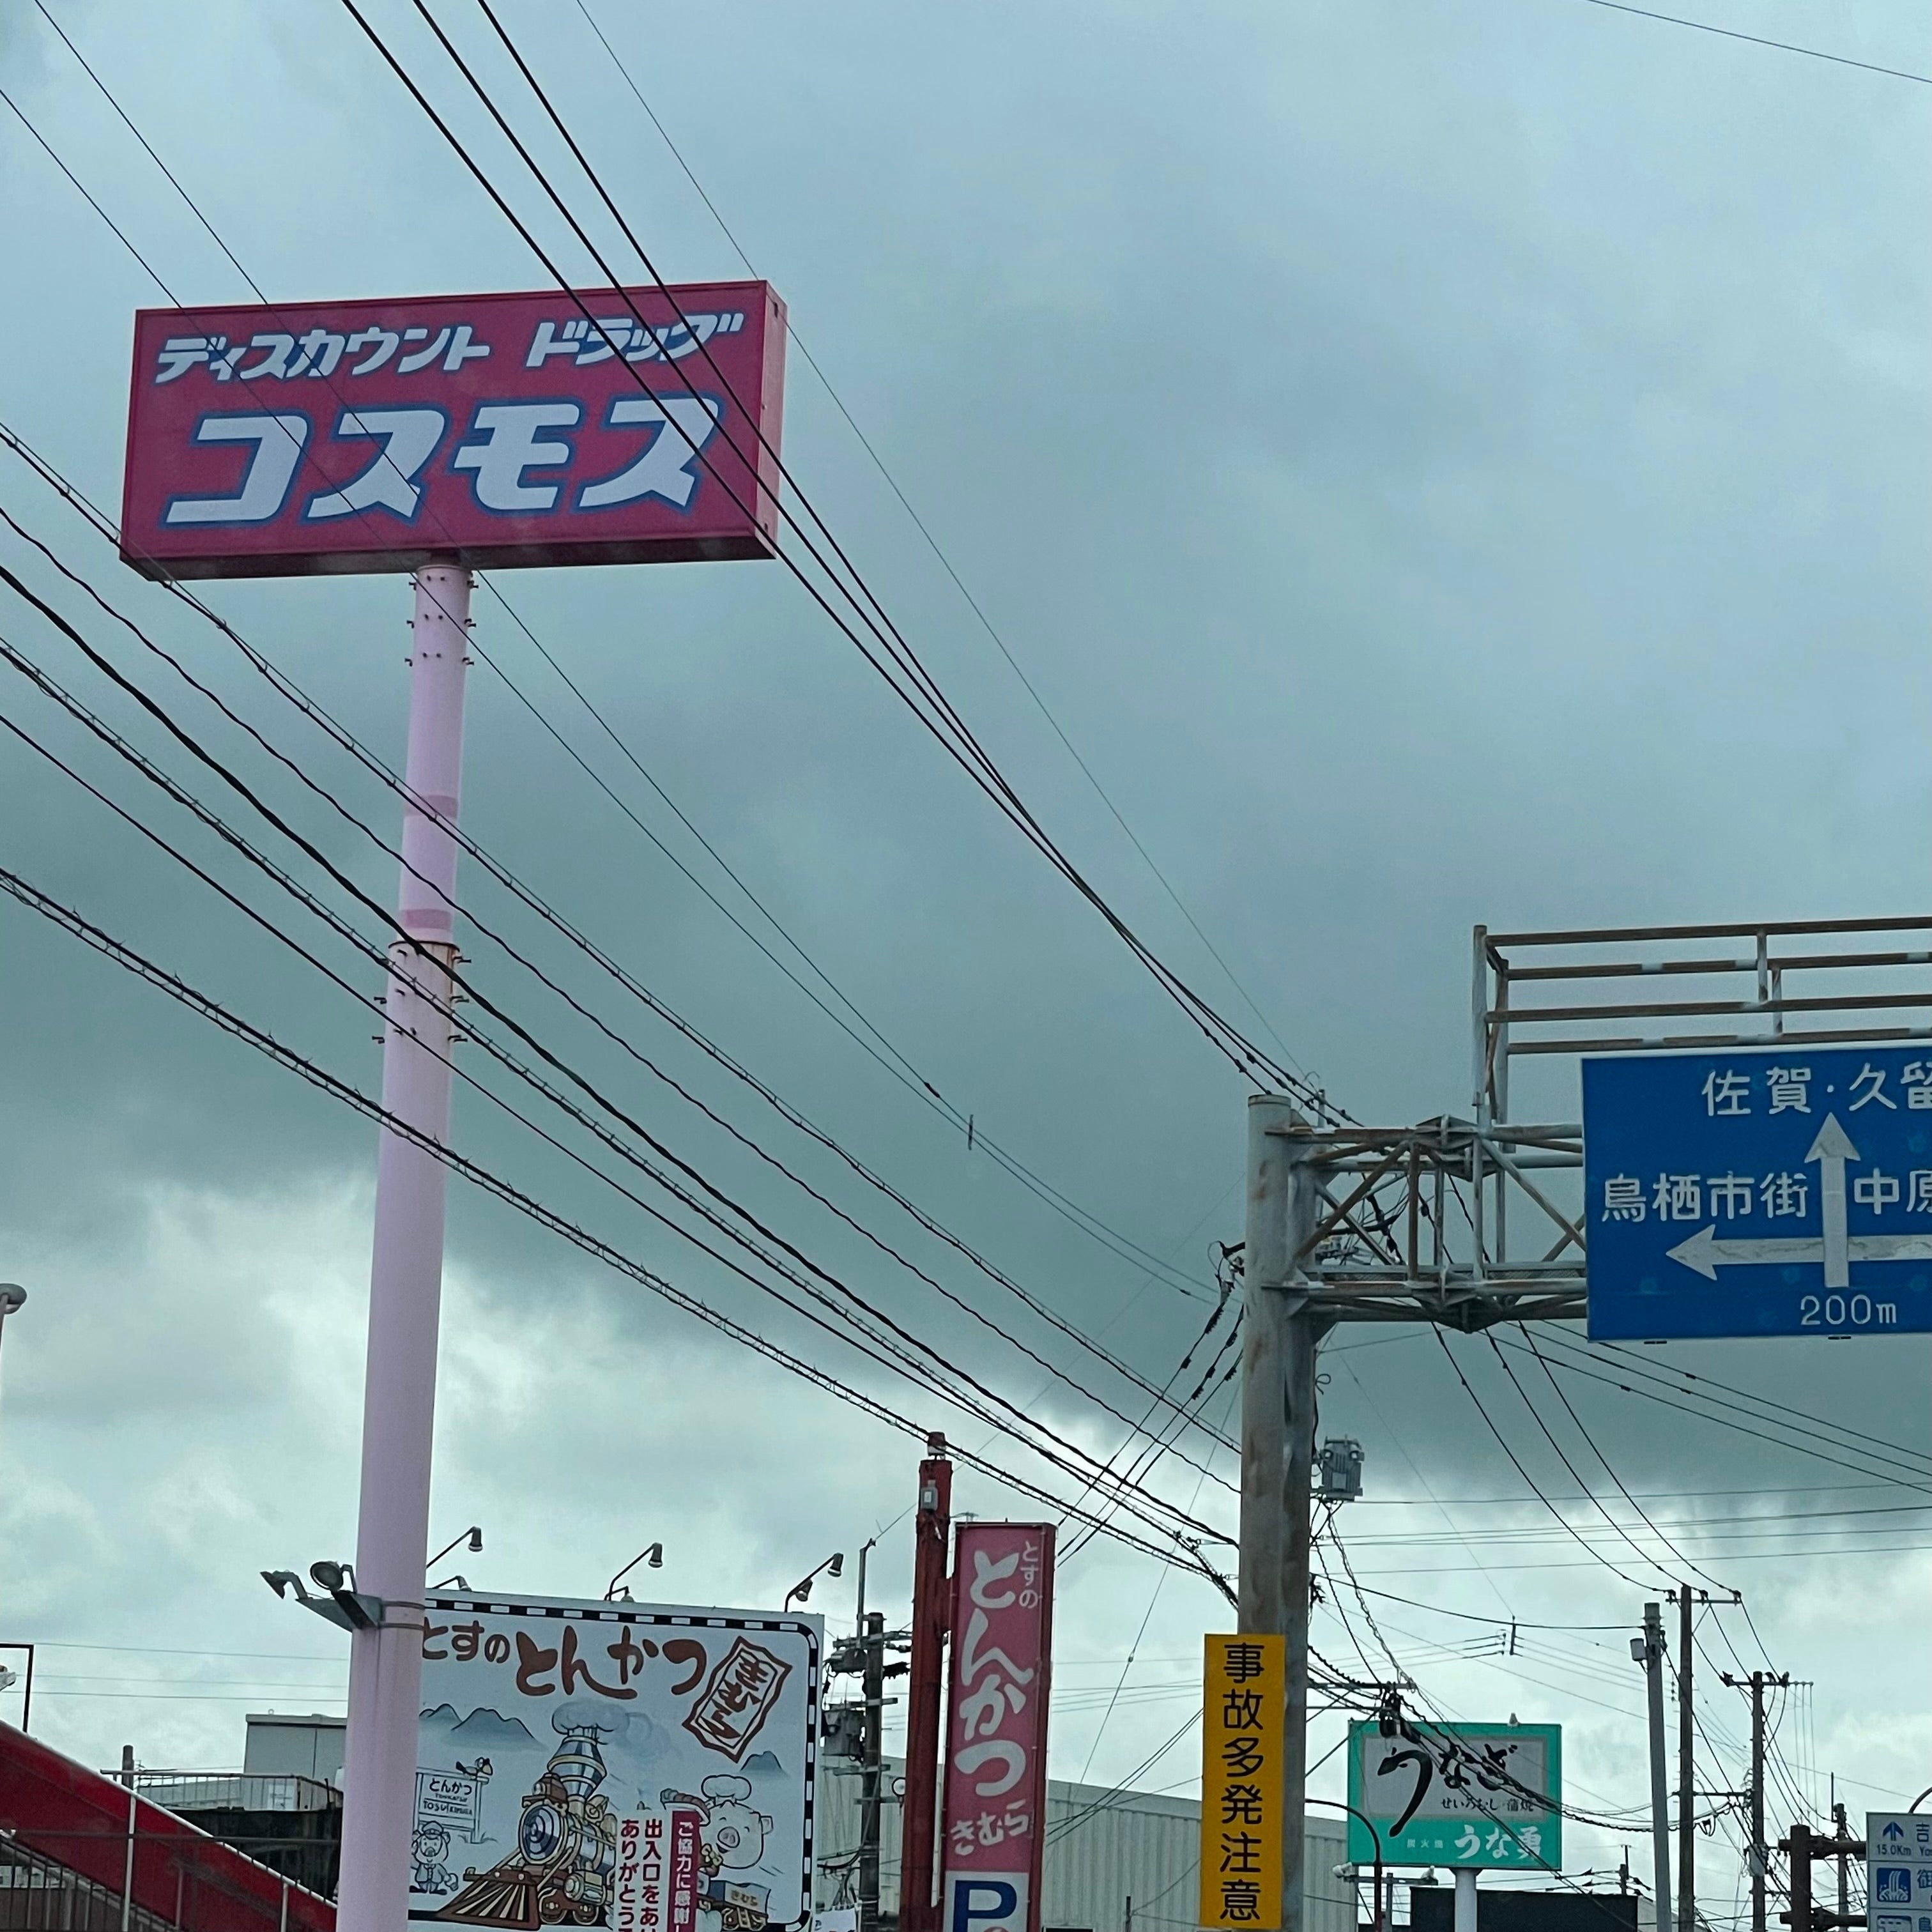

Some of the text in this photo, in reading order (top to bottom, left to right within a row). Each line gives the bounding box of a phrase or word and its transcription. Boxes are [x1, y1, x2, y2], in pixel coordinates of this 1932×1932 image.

[155, 312, 745, 383] ディスカウント ドラッグ
[165, 397, 719, 524] コスモス
[1602, 1170, 1809, 1222] 鳥栖市街
[1800, 1294, 1897, 1326] 200m
[1019, 1541, 1039, 1609] とすの
[516, 1625, 708, 1700] とんかつ
[954, 1549, 1034, 1796] とんかつ
[424, 1800, 447, 1811] TOSU
[429, 1778, 472, 1795] とんかつ
[1220, 1643, 1265, 1921] 事故多発注意
[951, 1800, 1029, 1857] きむら
[618, 1820, 640, 1932] ありがとう
[640, 1819, 662, 1932] 出入口をあ
[953, 1880, 1017, 1932] P
